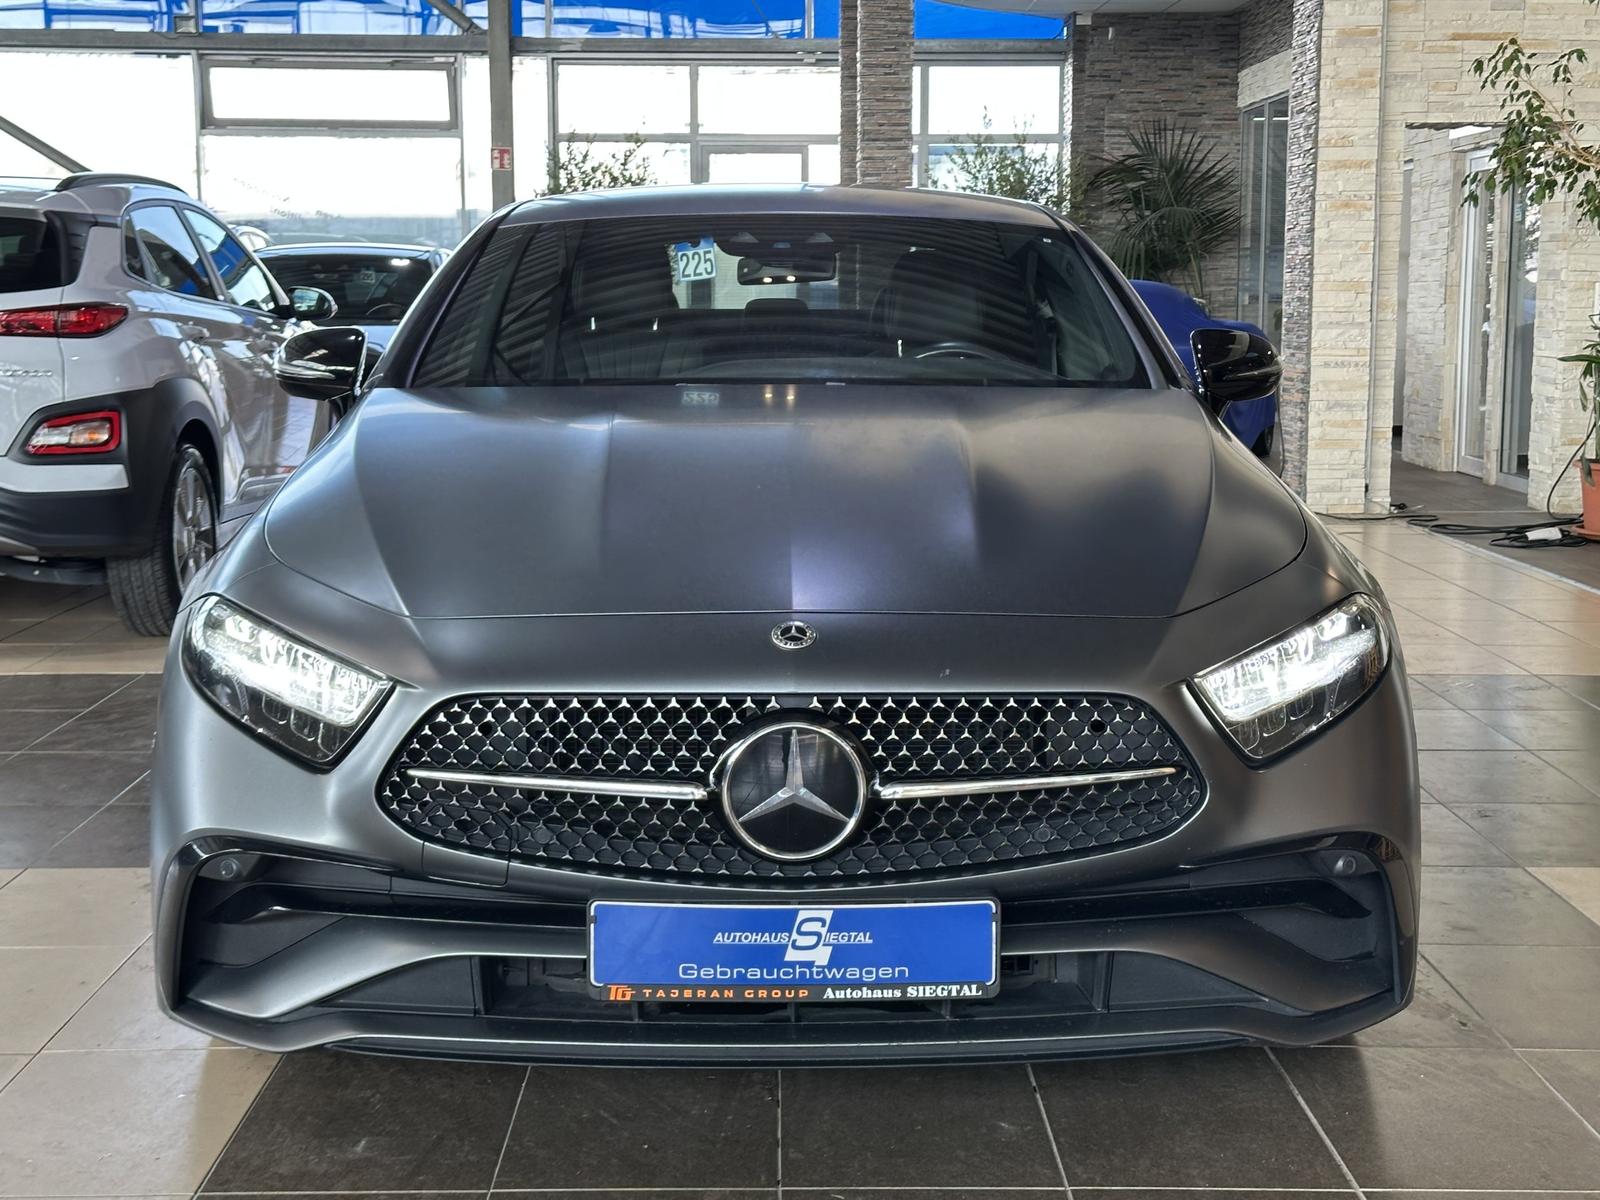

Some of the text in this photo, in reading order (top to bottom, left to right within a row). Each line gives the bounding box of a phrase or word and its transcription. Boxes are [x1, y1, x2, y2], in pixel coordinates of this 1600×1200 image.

[679, 250, 715, 278] 225
[713, 932, 790, 944] AUTOHAUS
[679, 963, 909, 982] Gebrauchtwagen
[643, 989, 734, 998] TAJERAN
[744, 989, 809, 998] GROUP
[823, 986, 902, 999] Autohaus
[907, 984, 982, 997] SIEGTAL
